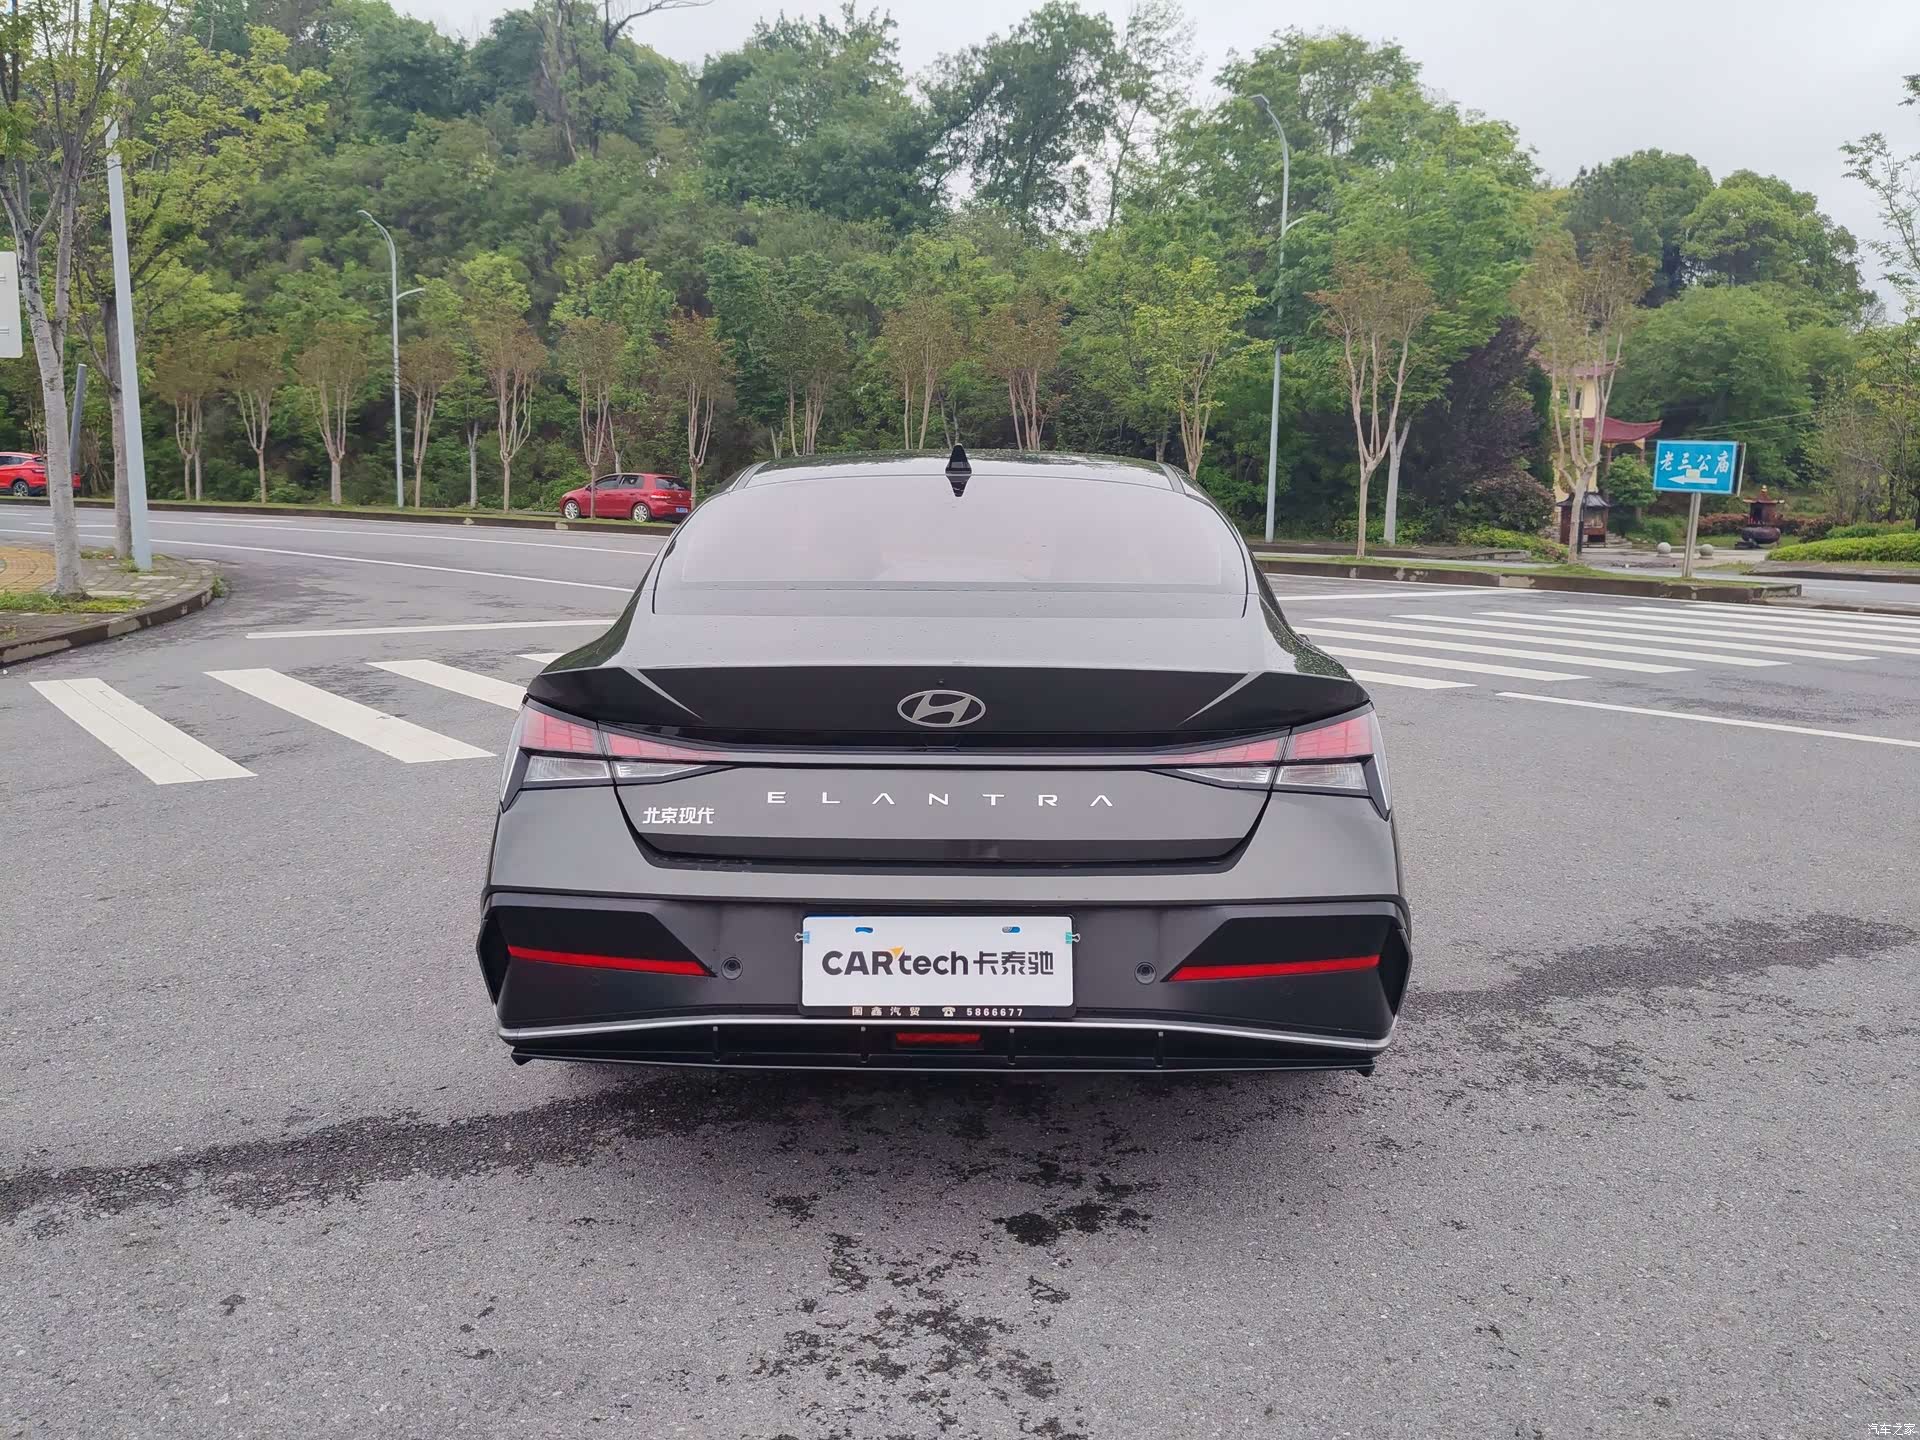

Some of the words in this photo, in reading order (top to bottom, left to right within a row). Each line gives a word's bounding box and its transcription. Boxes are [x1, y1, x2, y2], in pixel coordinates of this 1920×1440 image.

[767, 791, 1114, 807] ELANTRA
[642, 807, 715, 824] 北京现代
[966, 1007, 1023, 1017] 5866677
